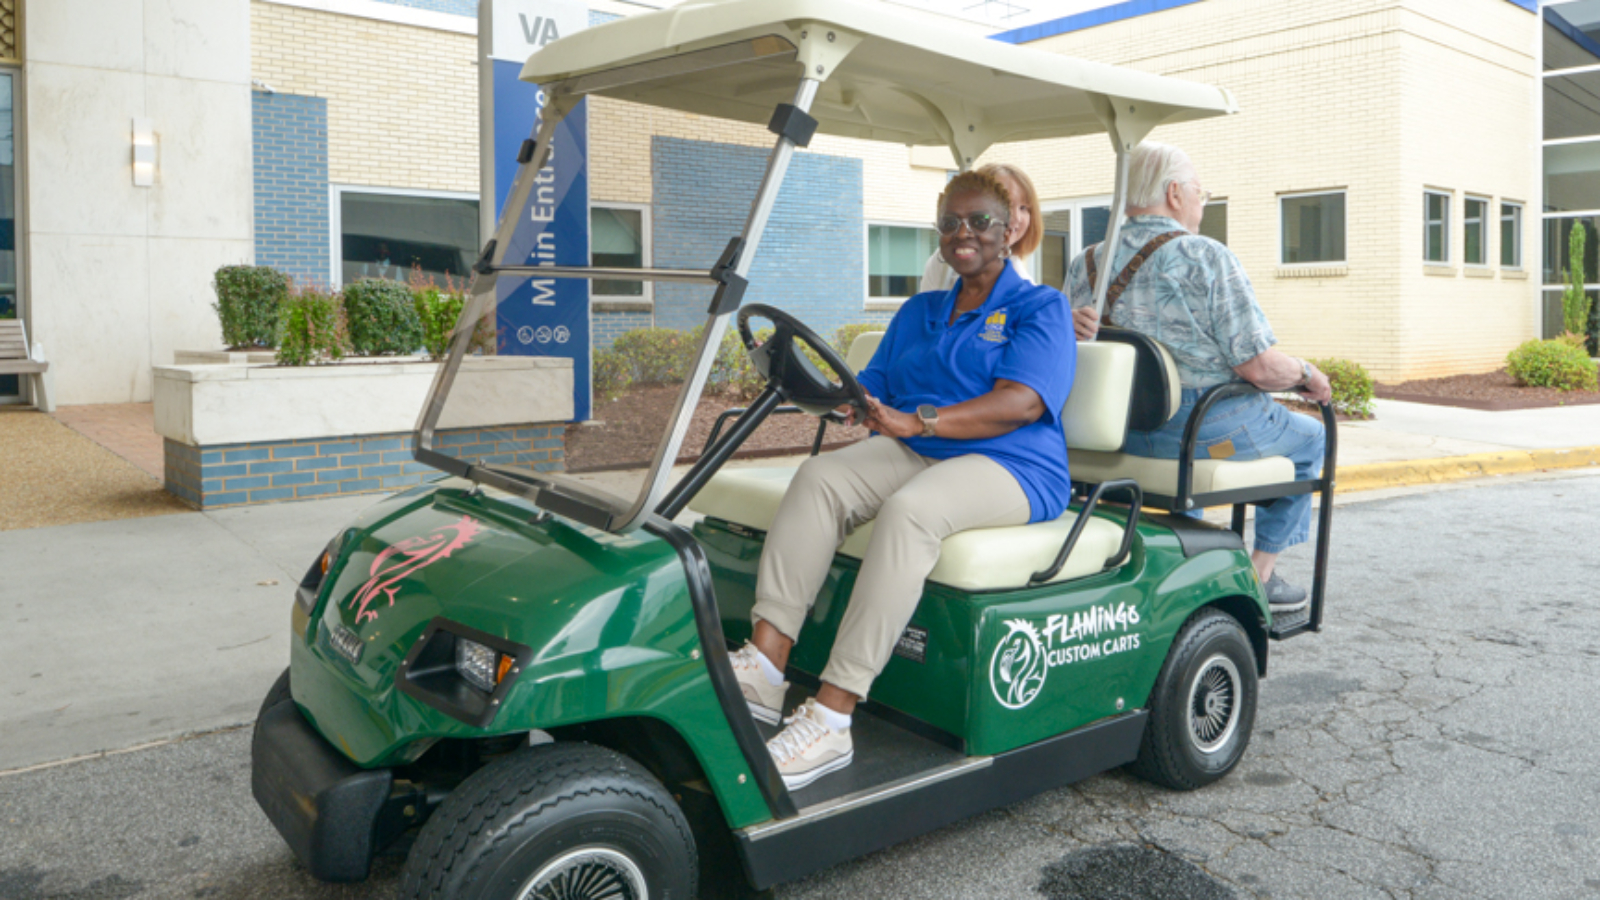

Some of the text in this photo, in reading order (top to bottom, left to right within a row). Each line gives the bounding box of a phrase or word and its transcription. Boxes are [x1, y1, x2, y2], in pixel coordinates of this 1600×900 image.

[518, 12, 560, 46] VA
[1047, 633, 1139, 667] CUSTOM CARTS
